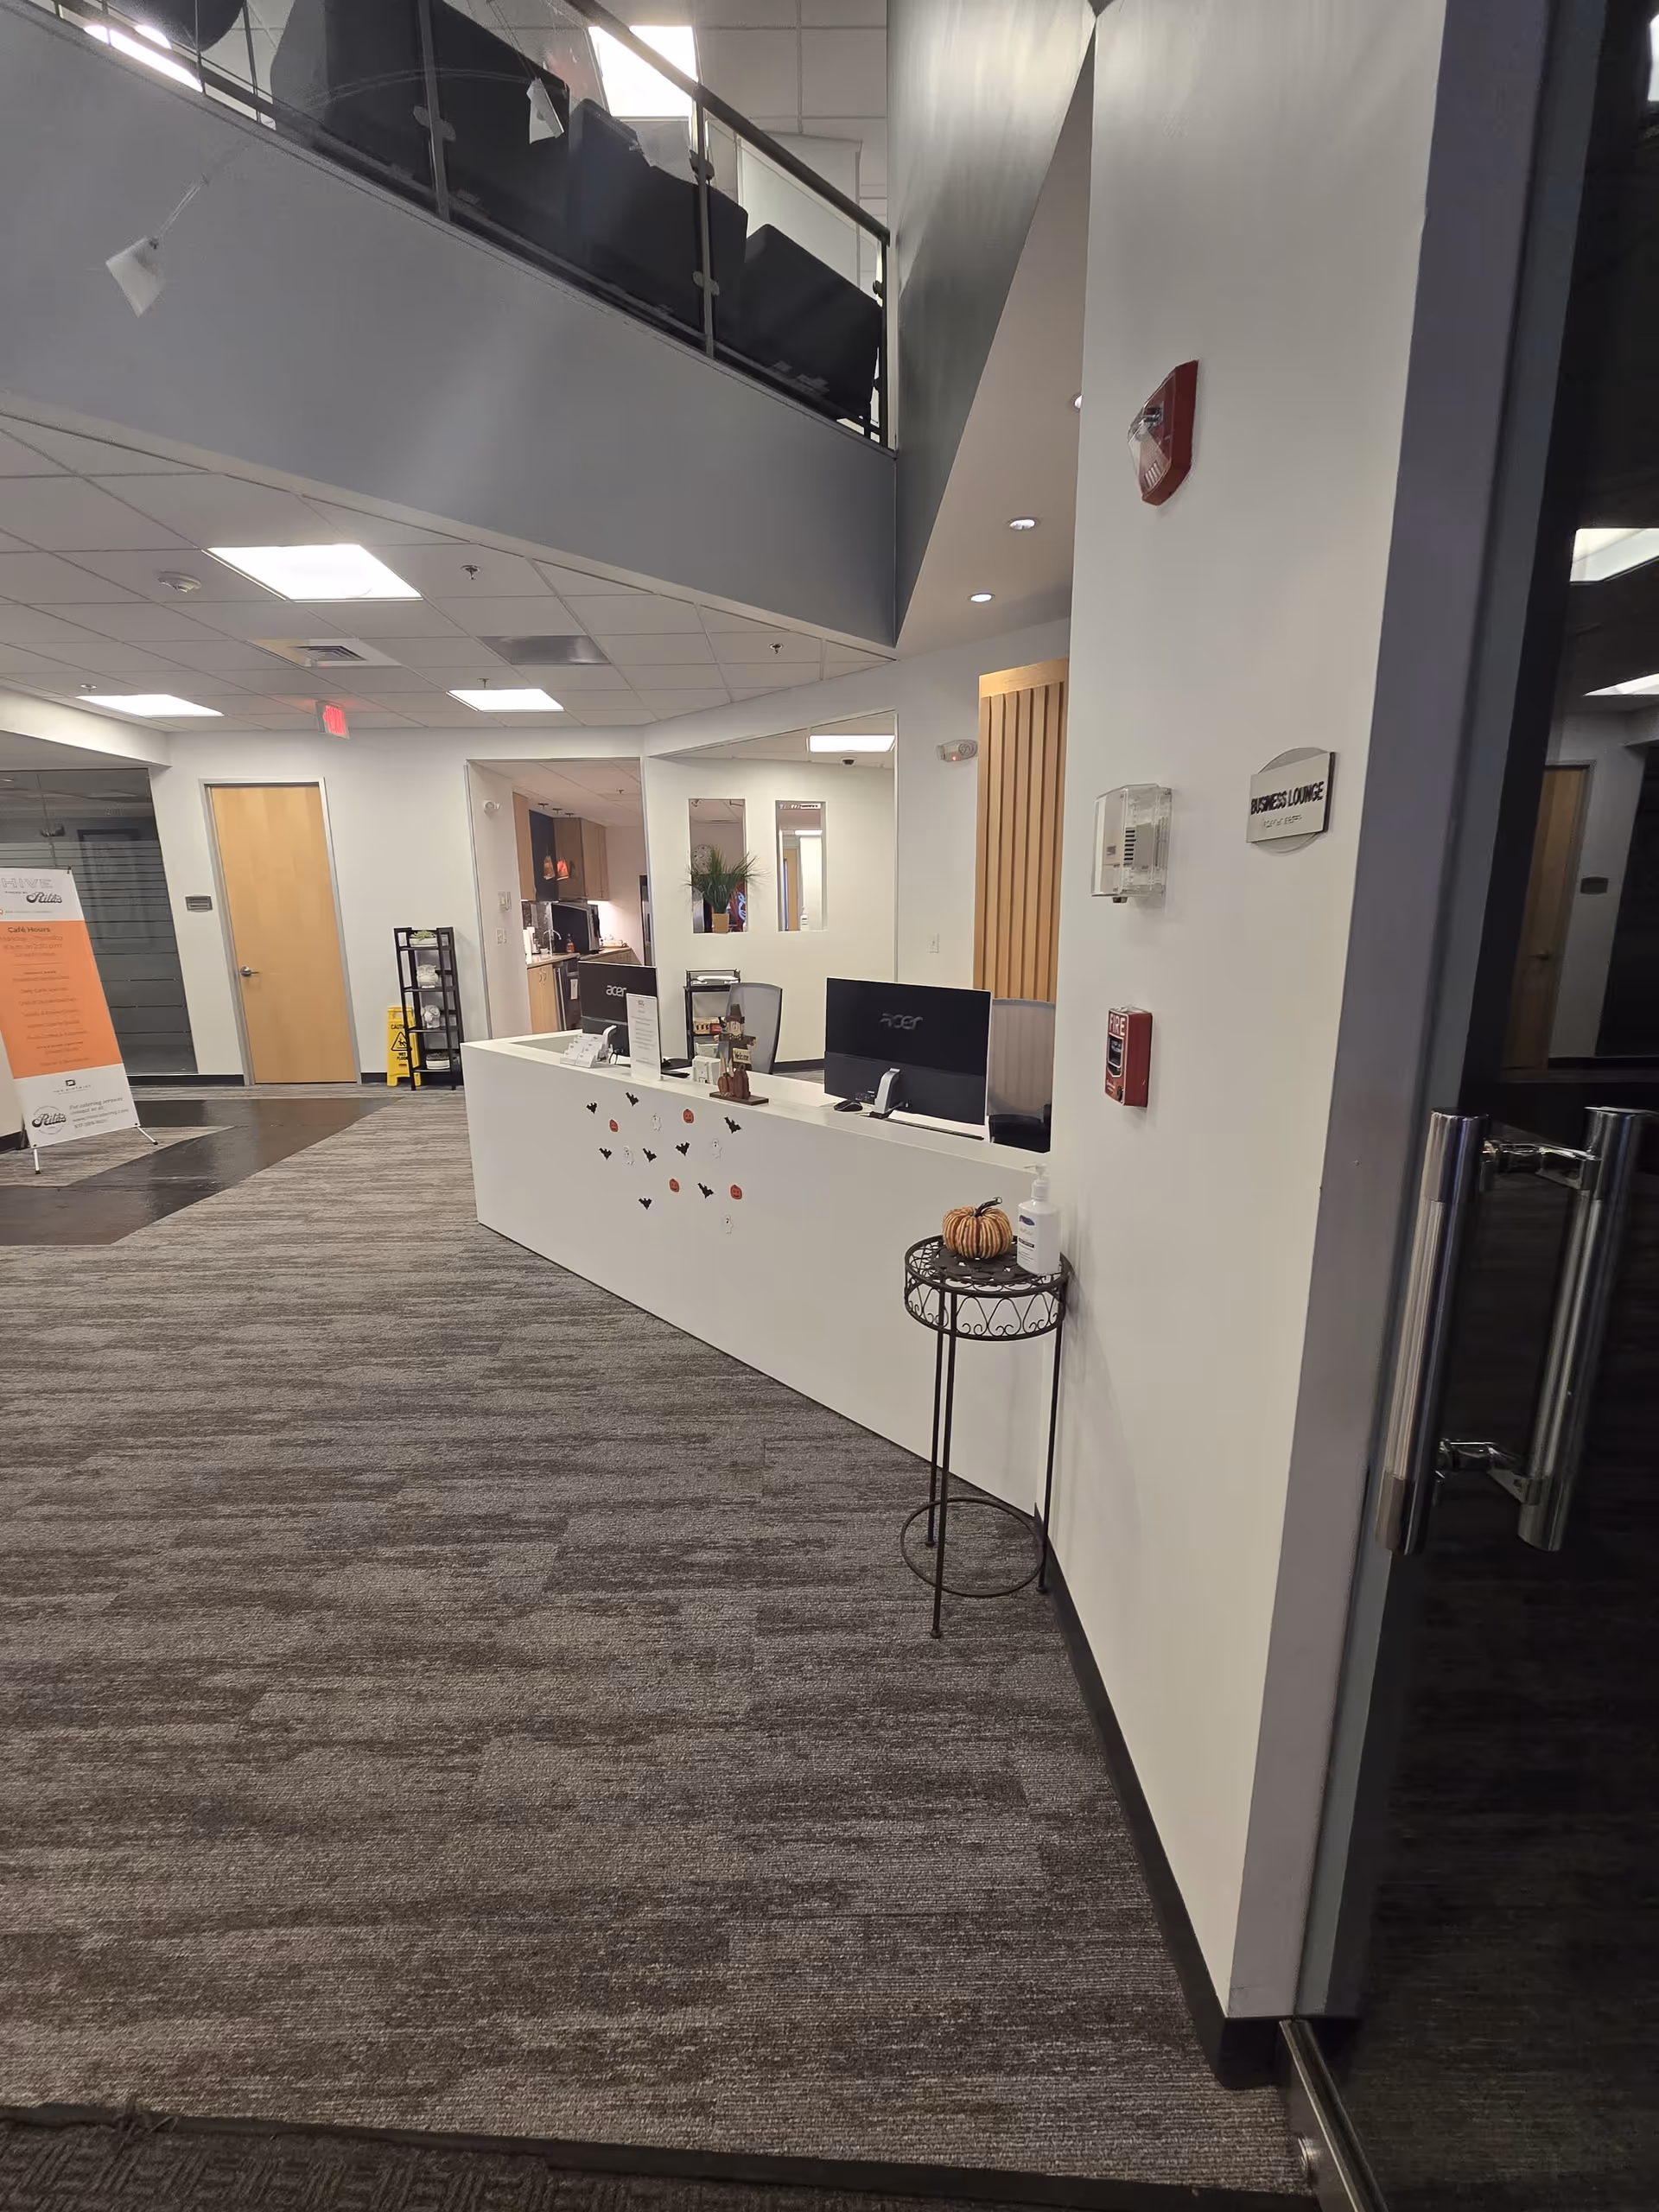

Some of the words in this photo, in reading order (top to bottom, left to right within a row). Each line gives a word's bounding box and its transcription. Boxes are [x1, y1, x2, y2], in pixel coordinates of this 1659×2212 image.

[1250, 790, 1287, 815] BUSINESS
[1287, 780, 1325, 807] LOUNGE
[1, 877, 54, 889] HIVE
[606, 985, 627, 997] acer
[880, 1013, 924, 1030] acer
[1109, 1013, 1126, 1036] FIRE
